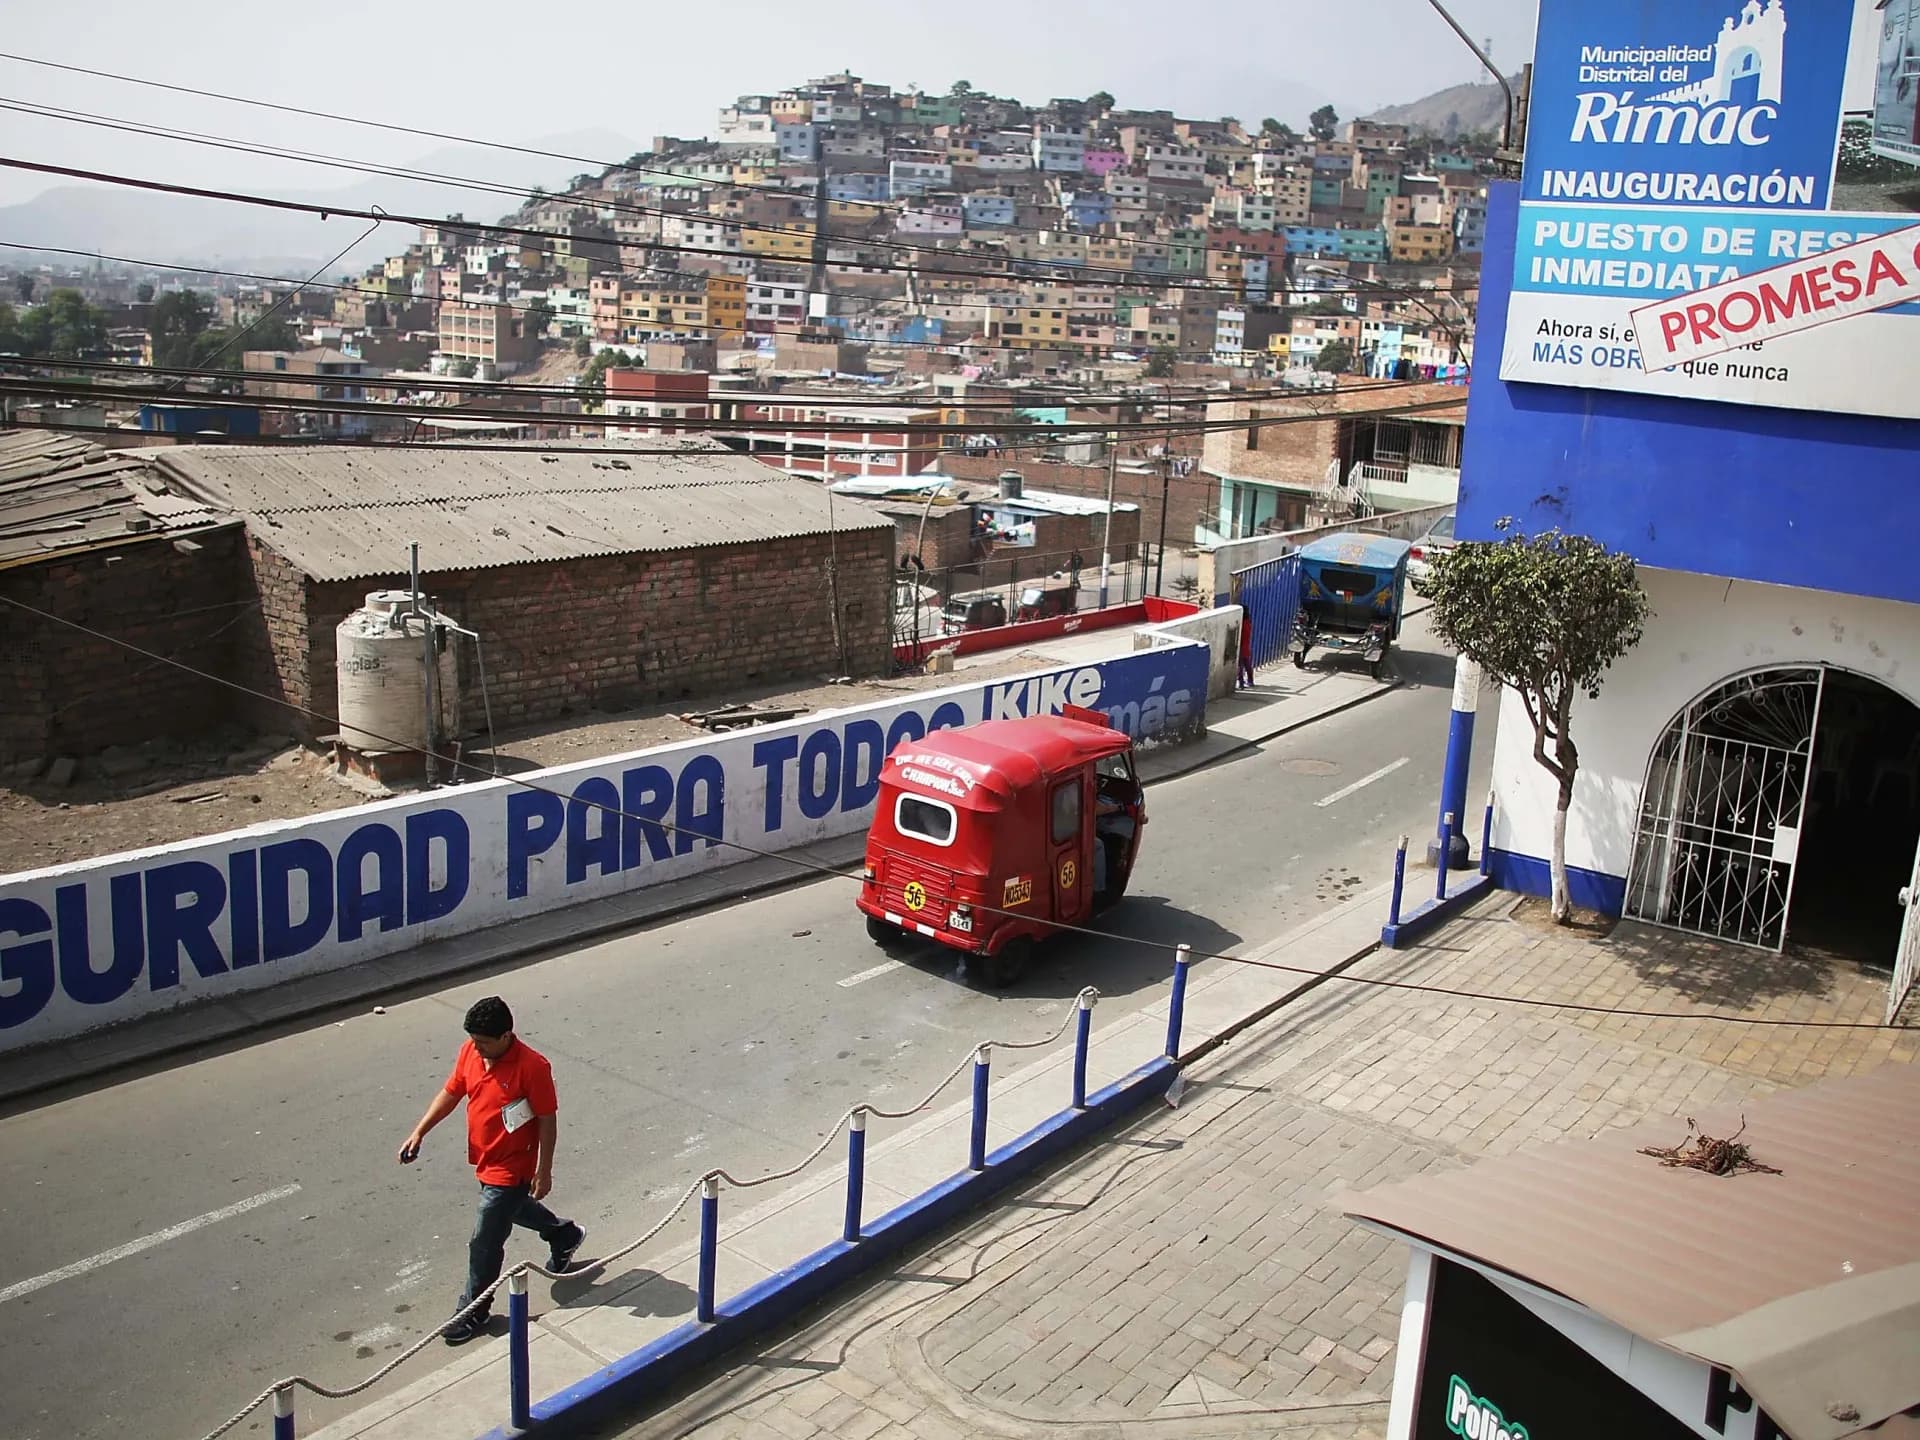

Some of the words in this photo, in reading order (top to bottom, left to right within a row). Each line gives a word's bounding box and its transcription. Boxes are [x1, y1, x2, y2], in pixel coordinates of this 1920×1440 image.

[1581, 45, 1712, 66] Municipalidad
[1579, 65, 1654, 82] Distrital
[1659, 65, 1688, 82] del
[1570, 91, 1777, 145] Rímac
[1541, 169, 1815, 204] INAUGURACIÓN
[1534, 221, 1688, 253] PUESTO
[1701, 228, 1755, 256] DE
[1660, 249, 1908, 353] PROMESA
[1537, 318, 1593, 338] Ahora
[1599, 323, 1619, 343] sí,
[1532, 339, 1583, 365] MÁS
[1682, 360, 1719, 378] que
[1726, 364, 1789, 382] nunca
[507, 755, 724, 900] PARA
[1061, 865, 1074, 884] 56
[906, 886, 921, 907] 56
